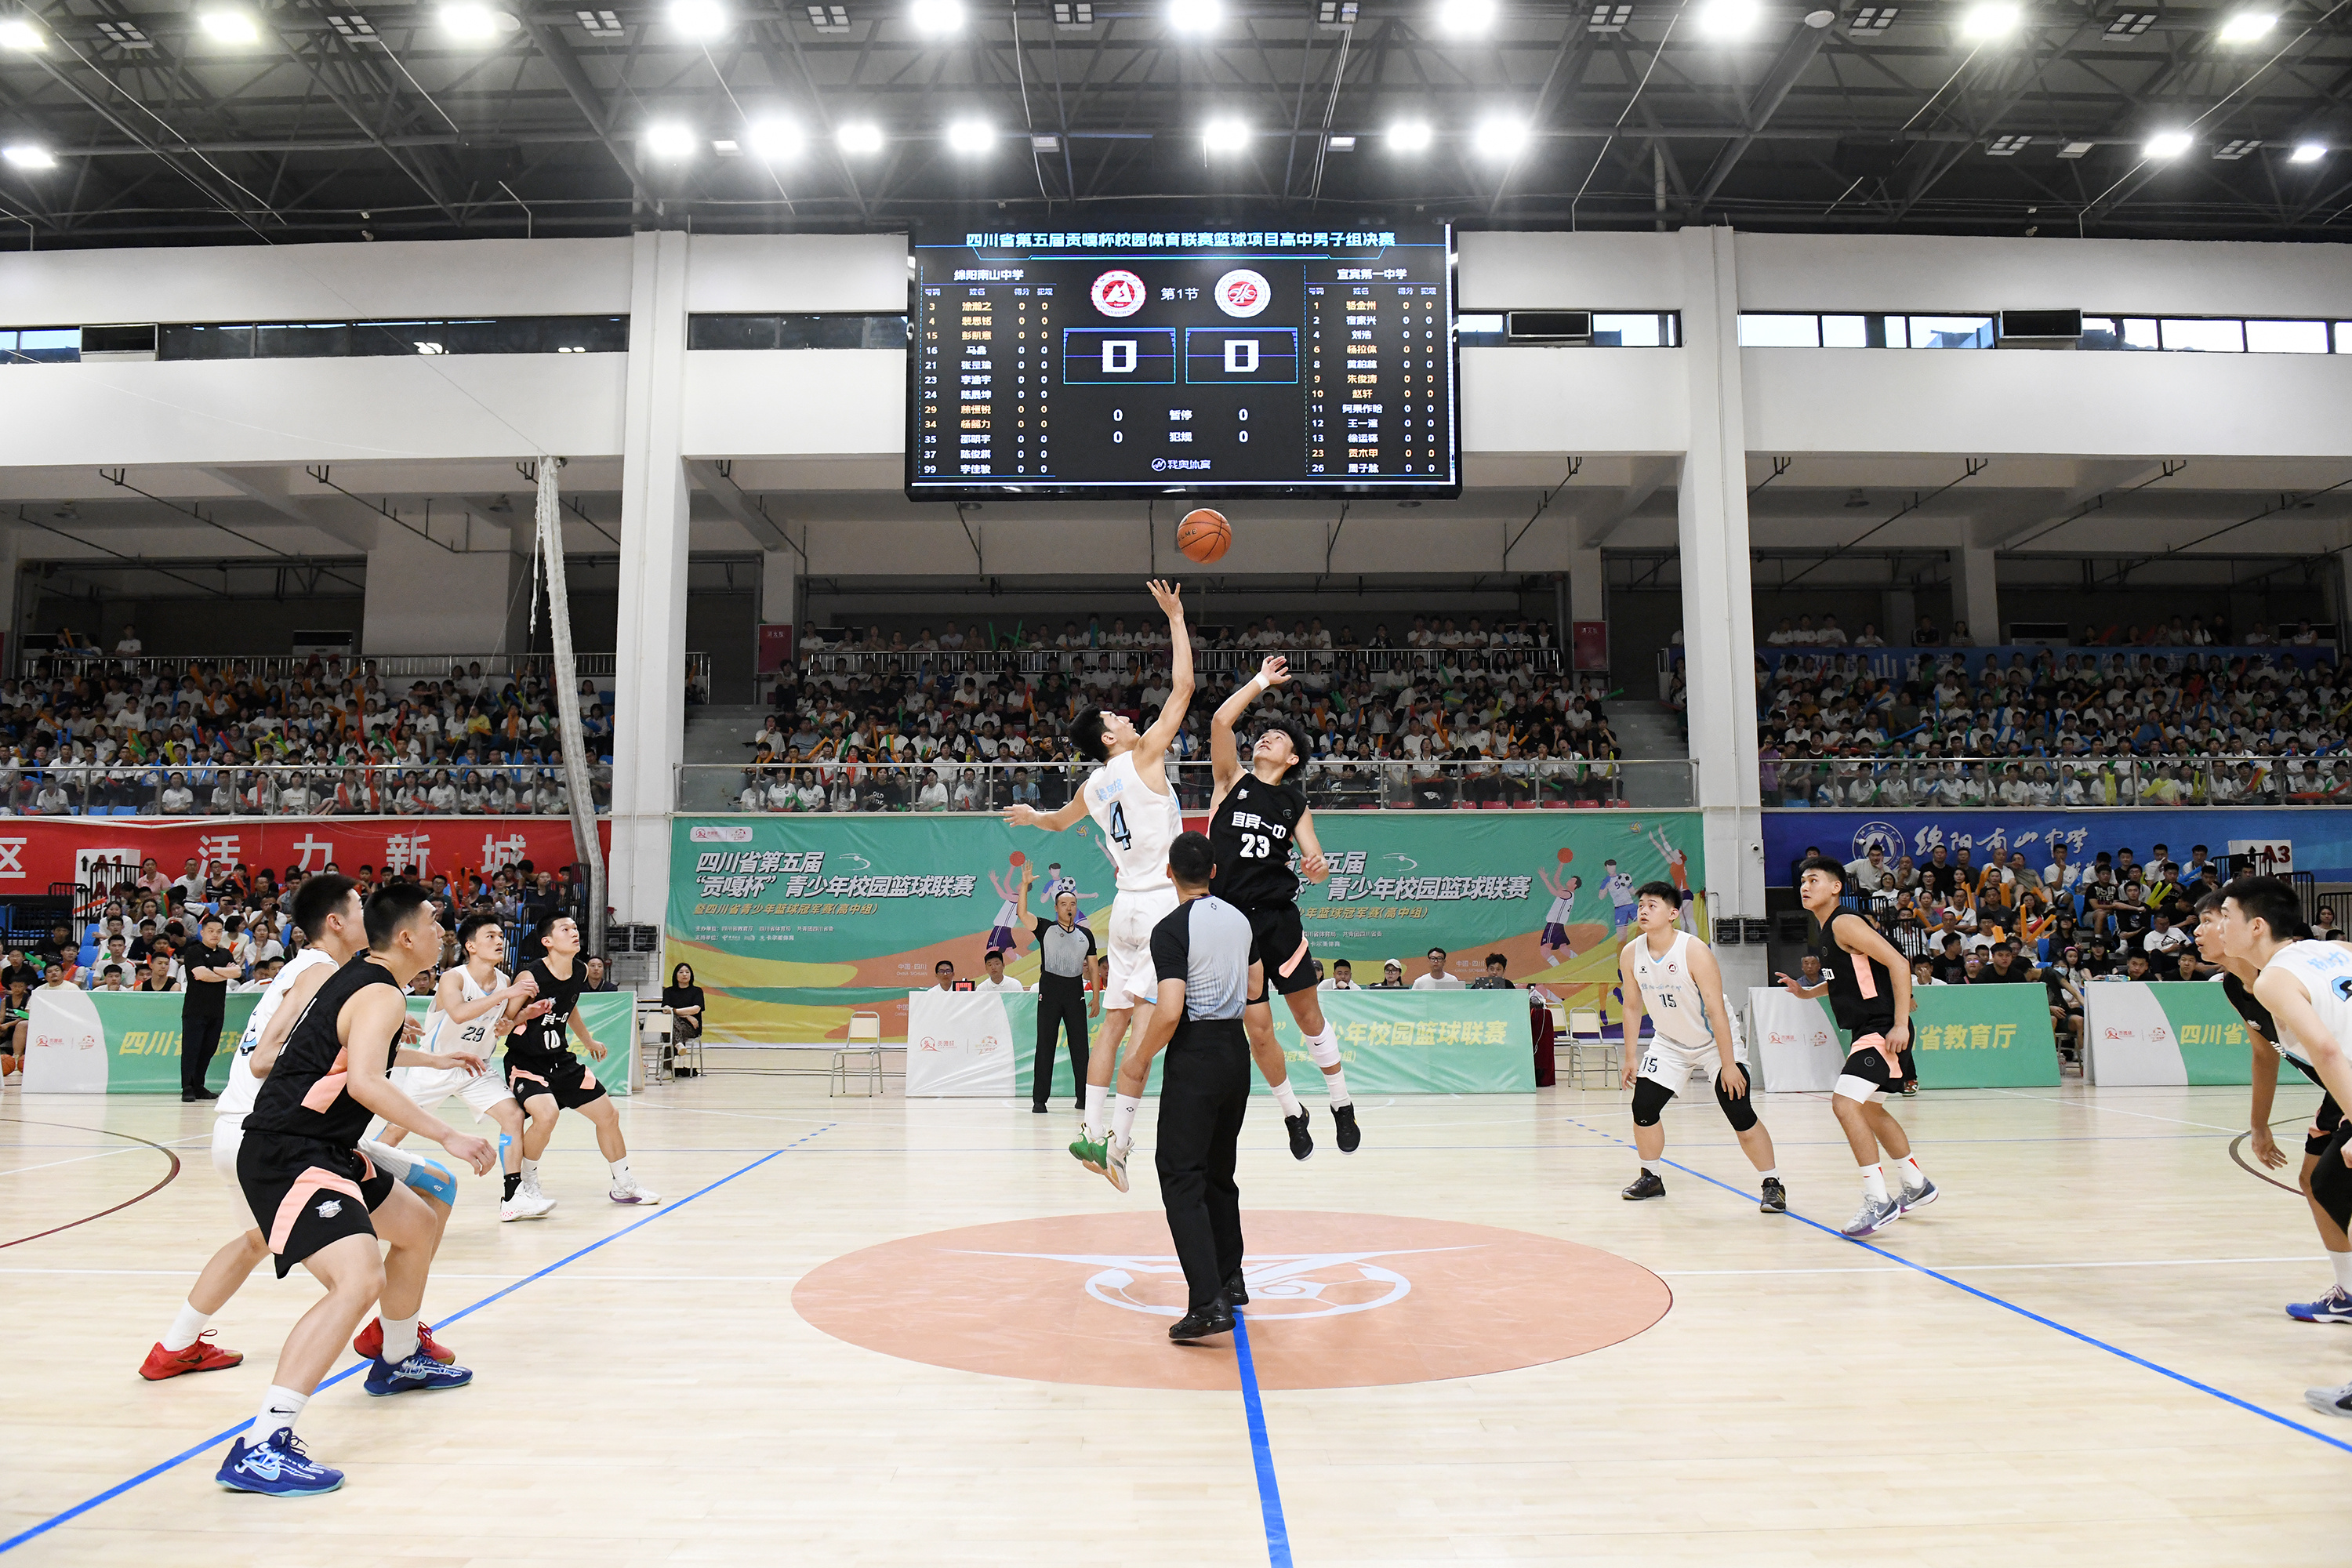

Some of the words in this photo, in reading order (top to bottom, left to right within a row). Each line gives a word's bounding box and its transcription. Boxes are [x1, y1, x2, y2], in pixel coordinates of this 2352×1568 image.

[953, 267, 1024, 282] 绵阳南山中学
[1337, 267, 1407, 280] 宜宾第一中学
[1161, 288, 1199, 300] 第1节
[1397, 286, 1414, 295] 得分
[928, 302, 935, 310] 3
[1425, 300, 1432, 309] 0
[1018, 316, 1025, 325] 0
[1040, 316, 1047, 325] 0
[1402, 315, 1410, 324] 0
[1425, 315, 1432, 325] 0
[926, 331, 938, 339] 15
[1312, 330, 1319, 339] 4
[1402, 330, 1410, 339] 0
[1425, 330, 1432, 339] 0
[926, 346, 938, 354] 16
[1018, 345, 1025, 354] 0
[1040, 345, 1047, 354] 0
[1102, 340, 1137, 372] 0
[1225, 339, 1259, 372] 0
[924, 361, 936, 369] 21
[1313, 360, 1320, 368] 8
[924, 376, 937, 384] 23
[1018, 375, 1025, 383] 0
[1040, 375, 1047, 383] 0
[1403, 374, 1410, 383] 0
[1017, 390, 1024, 398] 0
[1040, 390, 1047, 398] 0
[1427, 389, 1433, 397] 0
[1311, 404, 1323, 412] 11
[1403, 404, 1410, 412] 0
[1426, 404, 1434, 412] 0
[1113, 409, 1123, 421] 0
[1169, 409, 1192, 420] 暂停
[1239, 408, 1248, 420] 0
[1427, 419, 1434, 427] 0
[924, 434, 936, 443] 35
[1017, 434, 1024, 443] 0
[1040, 434, 1047, 443] 0
[1113, 431, 1123, 443] 0
[1169, 431, 1192, 442] 犯规
[1239, 430, 1248, 442] 0
[1312, 434, 1323, 442] 13
[1404, 434, 1411, 442] 0
[1427, 434, 1434, 442] 0
[924, 450, 936, 459] 37
[1017, 449, 1024, 458] 0
[1040, 449, 1047, 458] 0
[1312, 448, 1324, 457] 23
[1405, 448, 1411, 457] 0
[1428, 448, 1435, 457] 0
[924, 464, 936, 474] 99
[1017, 464, 1024, 473] 0
[1040, 464, 1047, 473] 0
[1311, 463, 1324, 472] 26
[1405, 463, 1412, 472] 0
[1428, 463, 1435, 472] 0
[1110, 800, 1131, 851] 4
[1232, 811, 1287, 840] 宜宾一中
[1240, 833, 1270, 859] 23
[2261, 845, 2290, 863] A3
[93, 855, 122, 873] A1
[695, 851, 826, 874] 四川省第五届
[784, 874, 977, 898] 青少年校园篮球联赛
[1327, 876, 1533, 902] 青少年校园篮球联赛
[1658, 993, 1678, 1008] 15
[461, 1025, 486, 1042] 29
[543, 1029, 561, 1051] 10
[1642, 1057, 1658, 1073] 15
